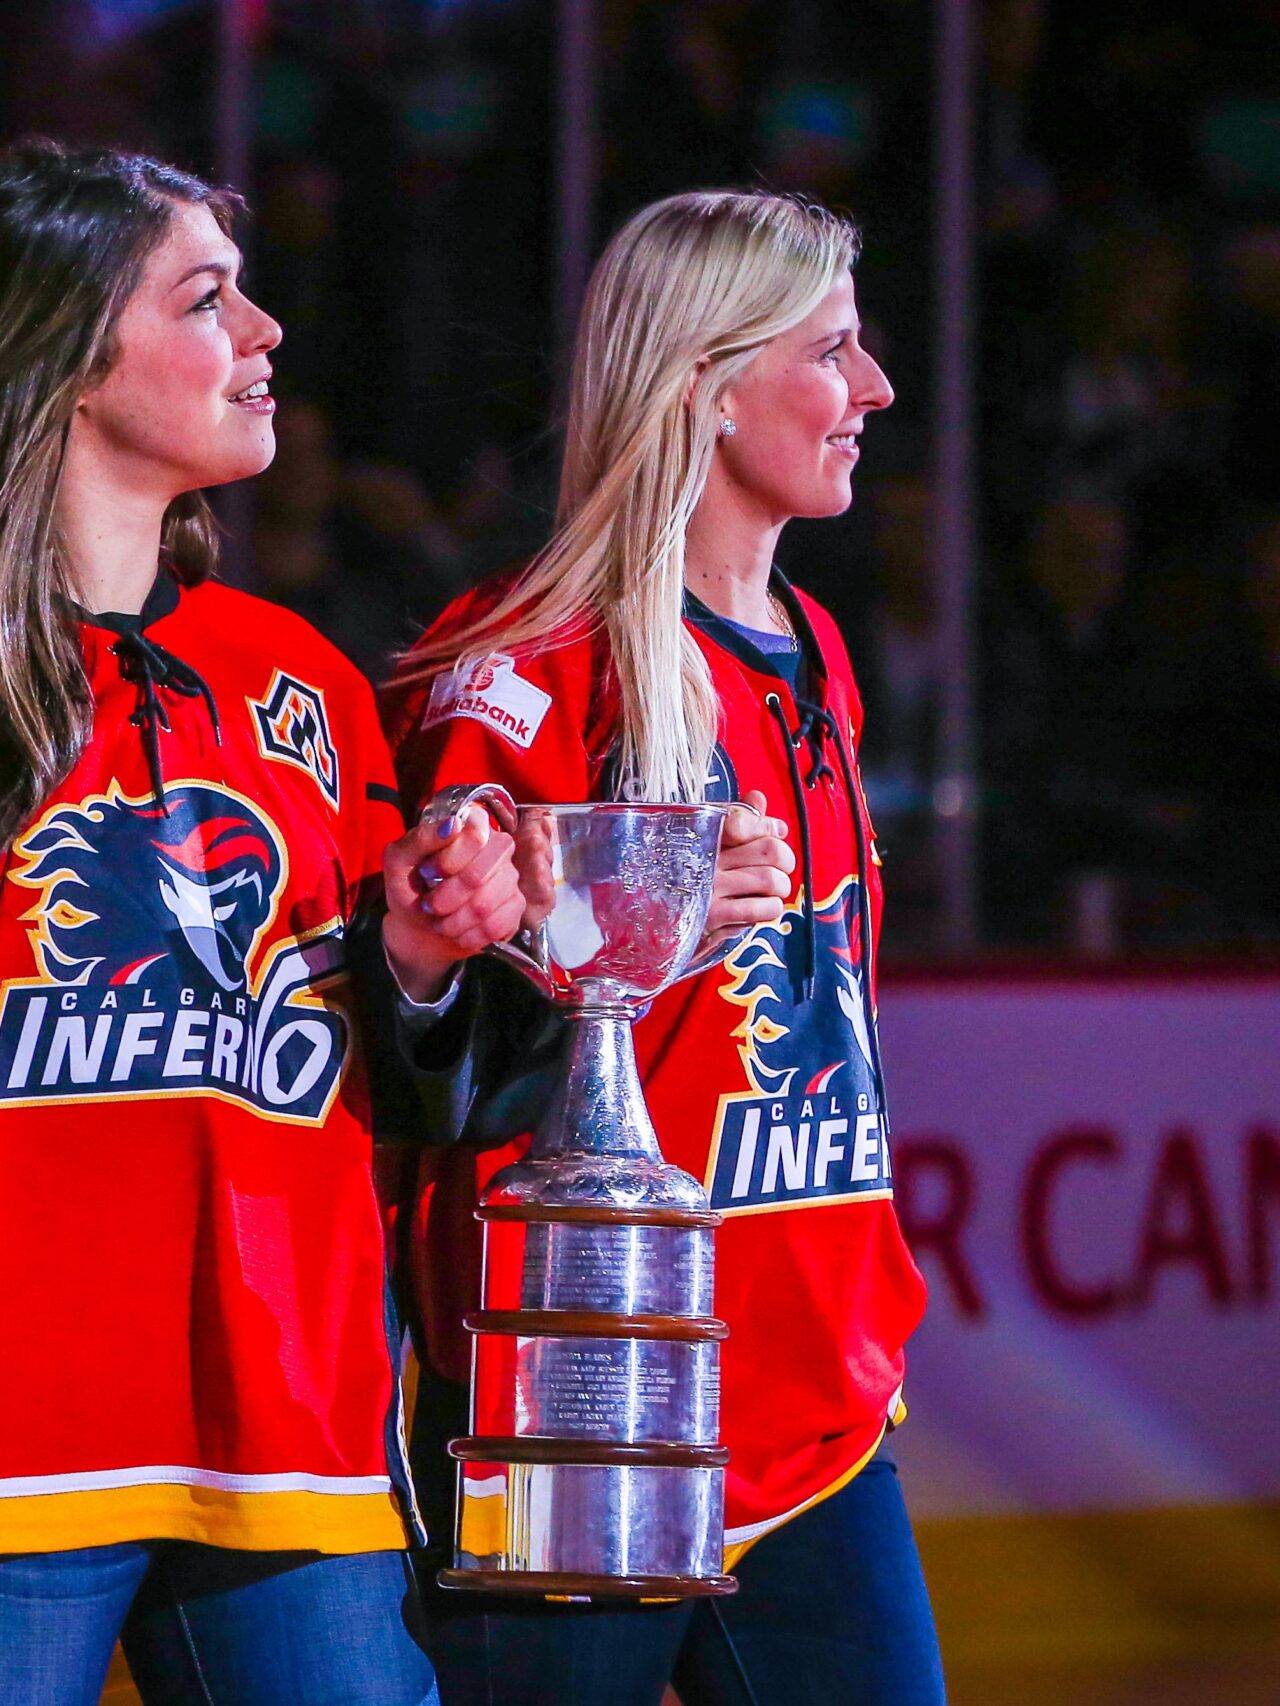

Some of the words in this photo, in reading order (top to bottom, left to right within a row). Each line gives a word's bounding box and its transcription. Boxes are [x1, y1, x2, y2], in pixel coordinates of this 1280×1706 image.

[60, 988, 252, 1015] CALGAR
[7, 992, 332, 1104] INFERNO
[771, 1092, 879, 1121] CALG
